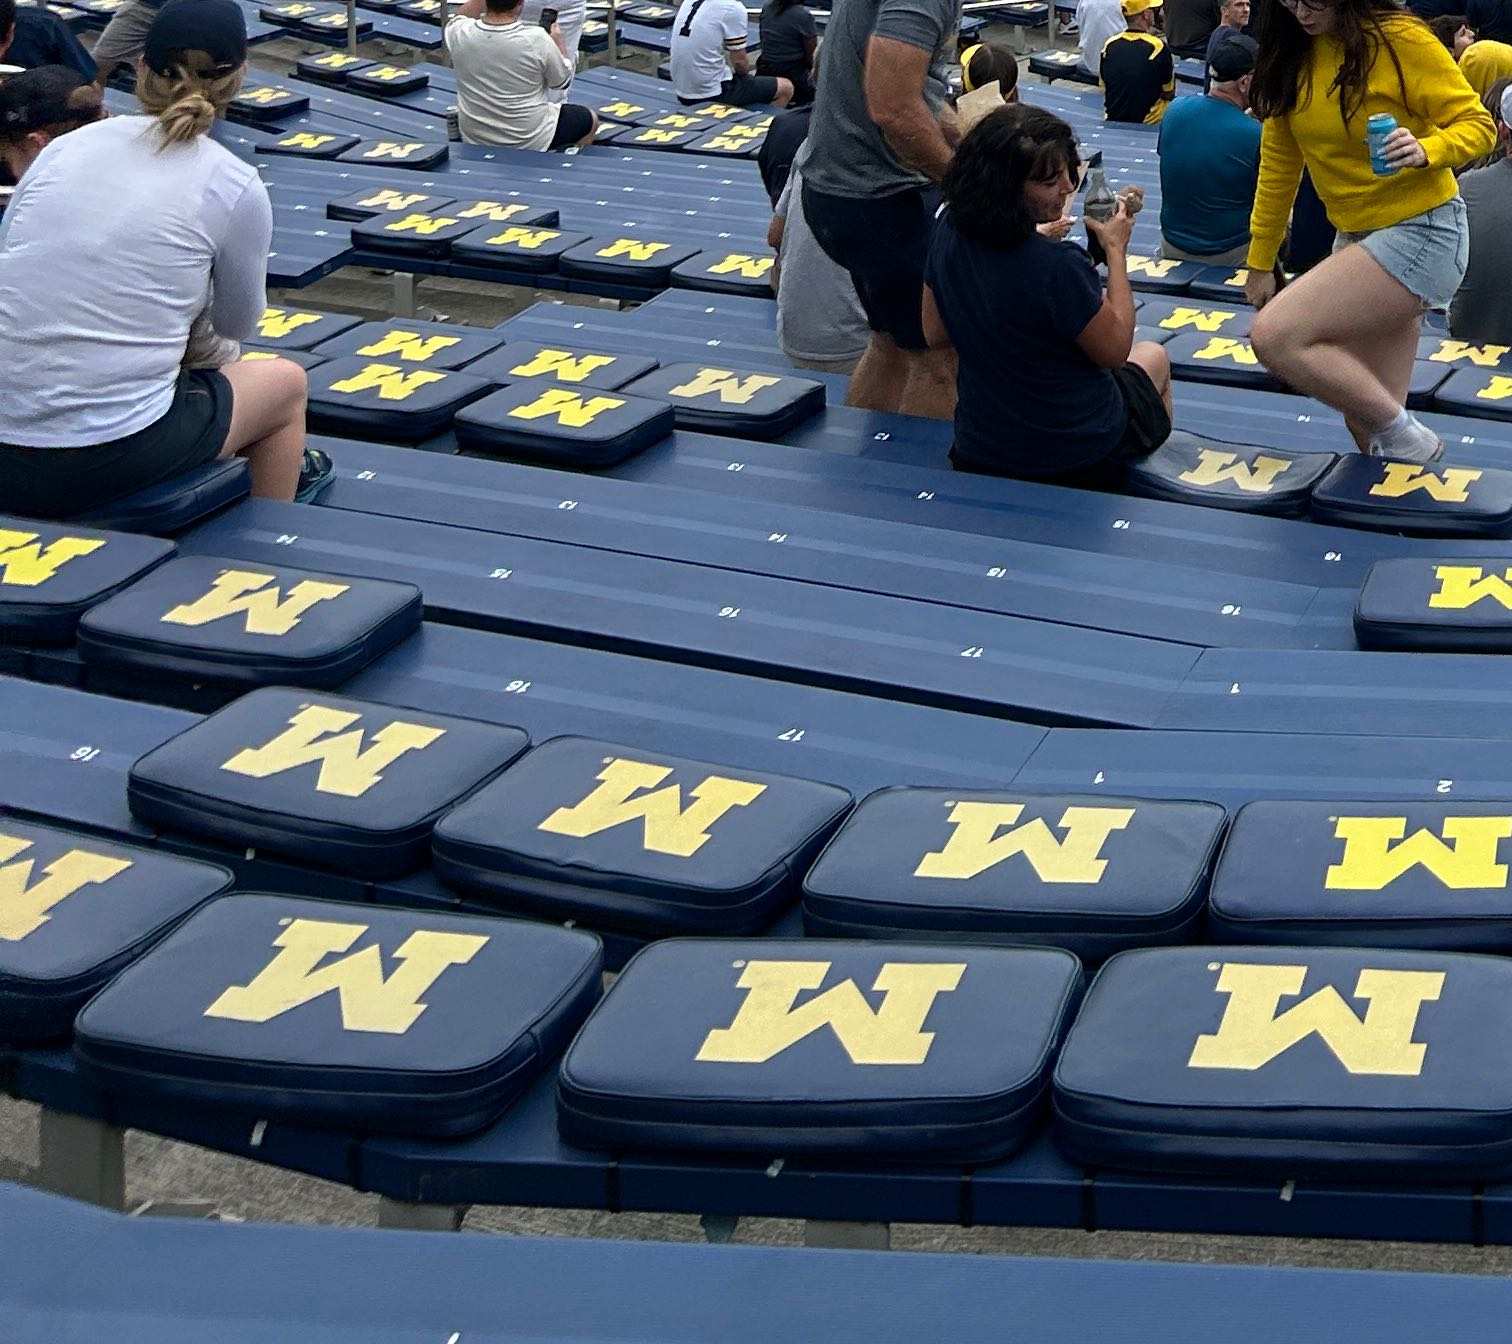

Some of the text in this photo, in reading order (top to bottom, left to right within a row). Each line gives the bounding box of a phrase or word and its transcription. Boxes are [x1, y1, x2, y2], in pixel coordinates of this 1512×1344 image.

[280, 133, 332, 149] M
[363, 143, 425, 157] M
[357, 190, 429, 210] M
[459, 202, 529, 220] M
[388, 214, 455, 233] M
[488, 227, 559, 248] M
[598, 240, 666, 260] M
[711, 254, 774, 277] M
[1161, 308, 1233, 331] M
[358, 330, 459, 361] M
[1195, 337, 1258, 364] M
[1431, 340, 1509, 366] M
[512, 349, 612, 382] M
[331, 364, 443, 399] M
[672, 369, 774, 402] M
[511, 389, 624, 427] M
[1181, 452, 1288, 490] M
[1371, 463, 1480, 501] M
[489, 568, 513, 579] 15
[986, 567, 1007, 578] 15
[165, 570, 345, 633] M
[718, 606, 741, 618] 16
[1220, 604, 1241, 616] 16
[960, 646, 984, 658] 17
[505, 680, 531, 694] 16
[1230, 682, 1240, 694] 1
[777, 728, 805, 742] 17
[69, 746, 100, 762] 16
[224, 706, 442, 795] M
[1093, 771, 1105, 784] 1
[1436, 780, 1453, 793] 2
[540, 759, 764, 856] M
[917, 802, 1132, 882] M
[1325, 816, 1512, 890] M
[208, 919, 486, 1031] M
[699, 961, 964, 1063] M
[1191, 963, 1444, 1075] M
